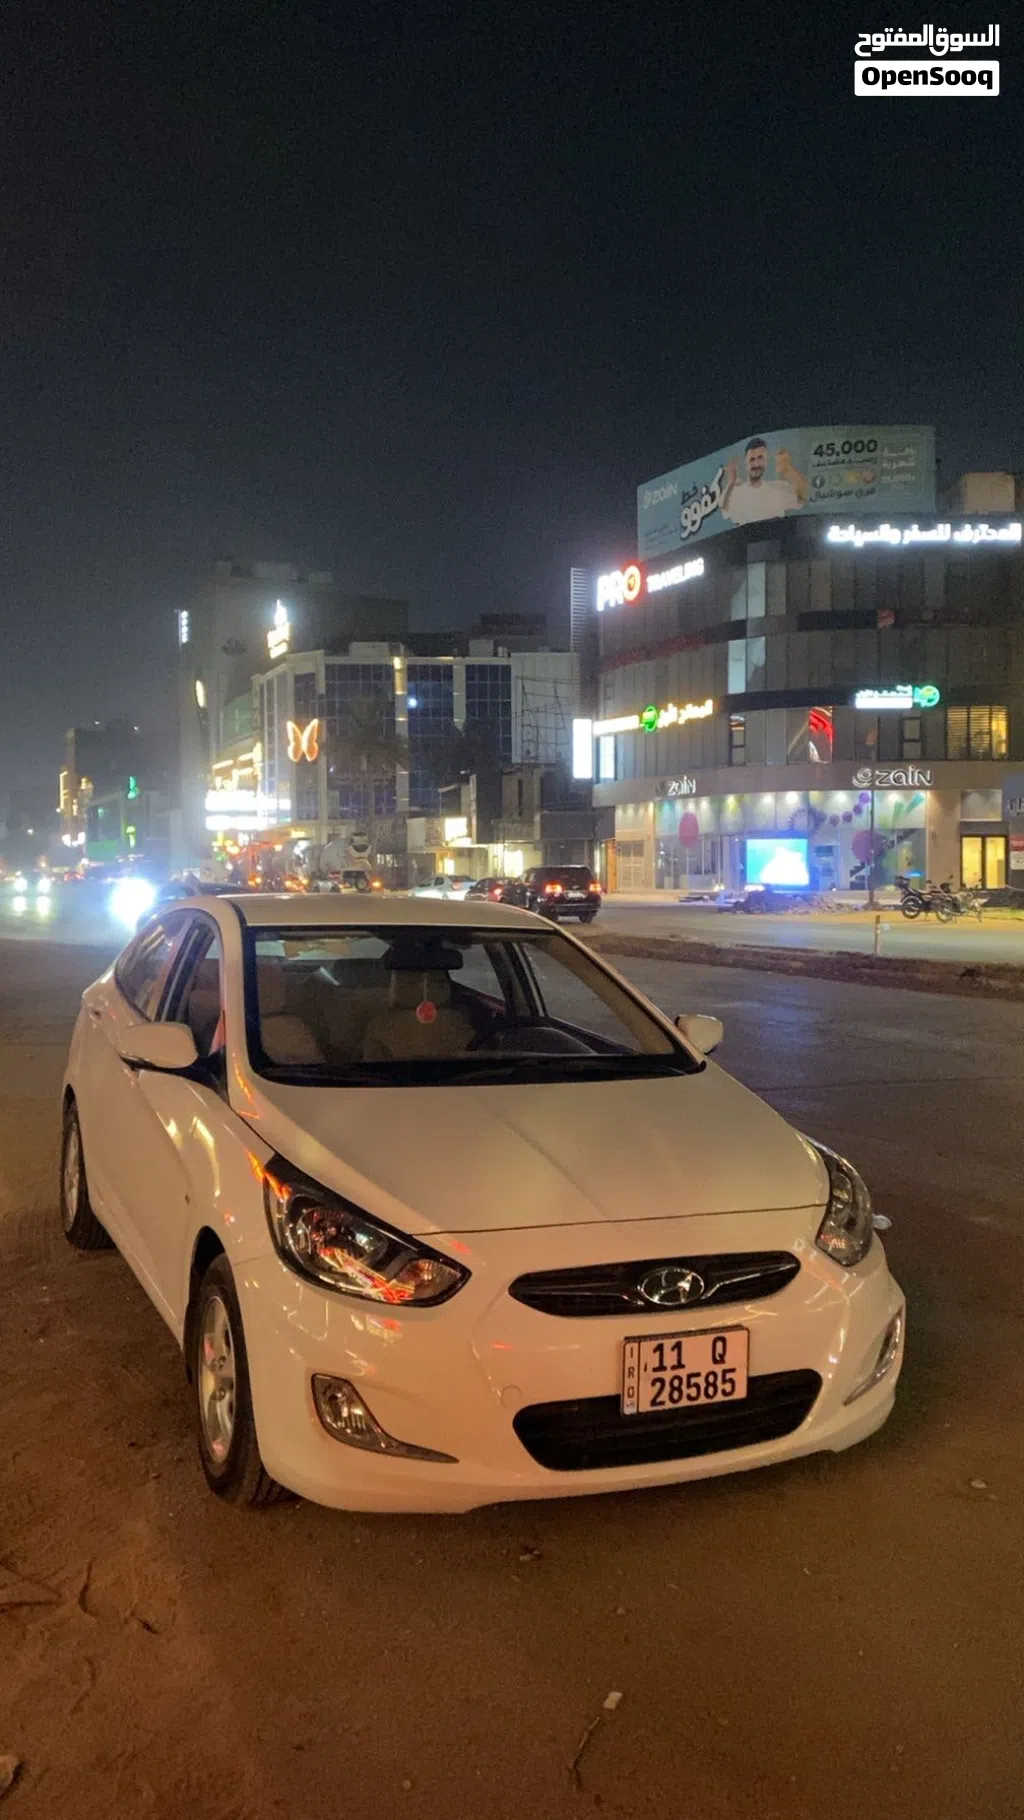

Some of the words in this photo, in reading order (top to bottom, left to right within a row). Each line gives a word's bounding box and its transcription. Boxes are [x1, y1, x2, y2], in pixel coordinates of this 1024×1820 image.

[813, 440, 878, 457] 45,000
[902, 523, 951, 544] للسفر
[597, 565, 641, 611] PRO
[875, 765, 933, 786] zain
[652, 1341, 685, 1373] 11
[711, 1335, 727, 1365] Q
[650, 1368, 736, 1407] 28585
